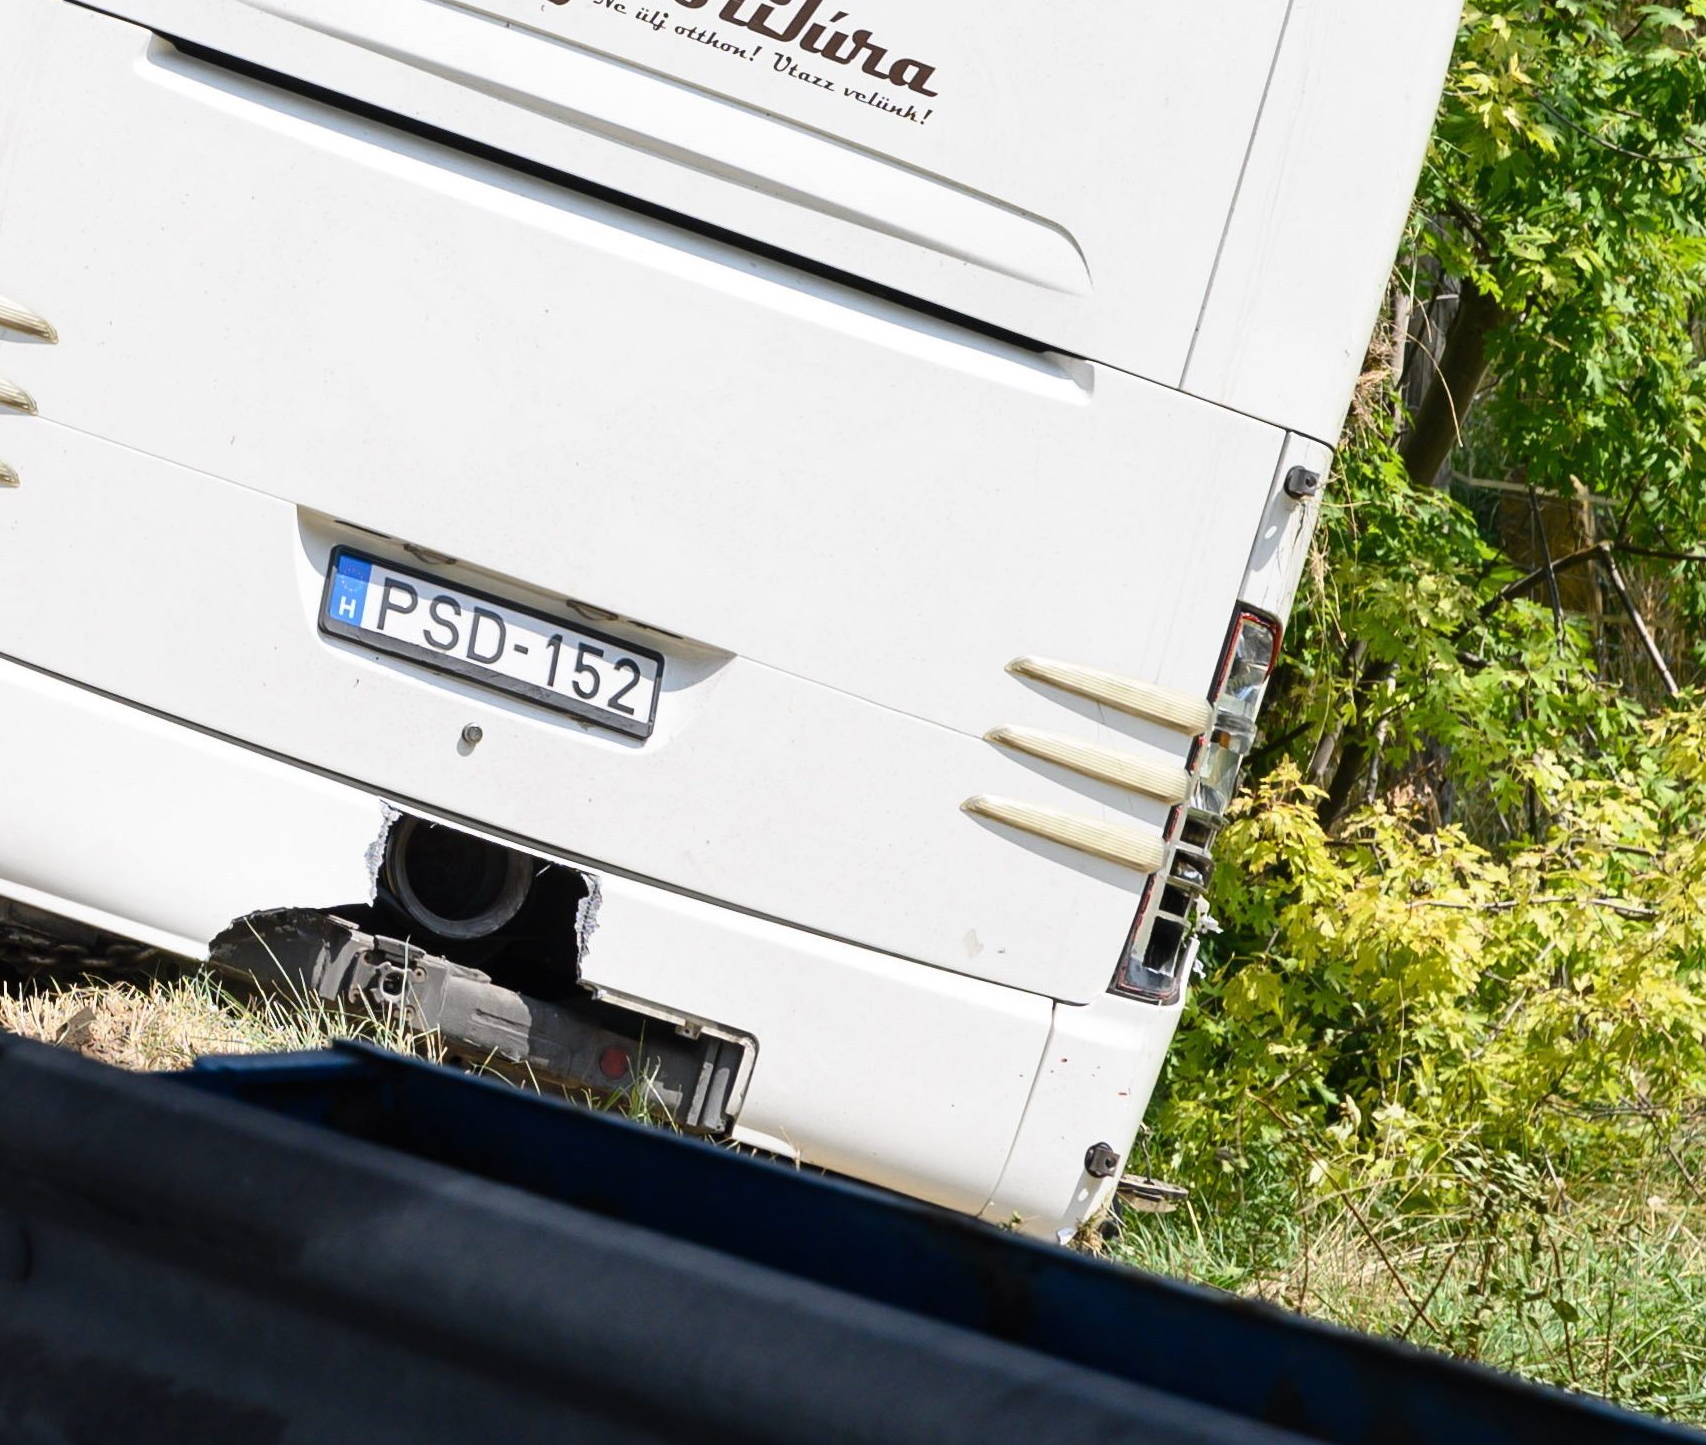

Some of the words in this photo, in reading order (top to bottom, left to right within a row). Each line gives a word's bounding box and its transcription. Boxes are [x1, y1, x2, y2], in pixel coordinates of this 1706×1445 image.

[635, 6, 667, 32] ülj
[674, 25, 764, 62] otthon!
[772, 52, 836, 93] Utazz
[843, 87, 934, 126] velünk!
[338, 595, 357, 619] H
[376, 576, 642, 716] PSD-152
